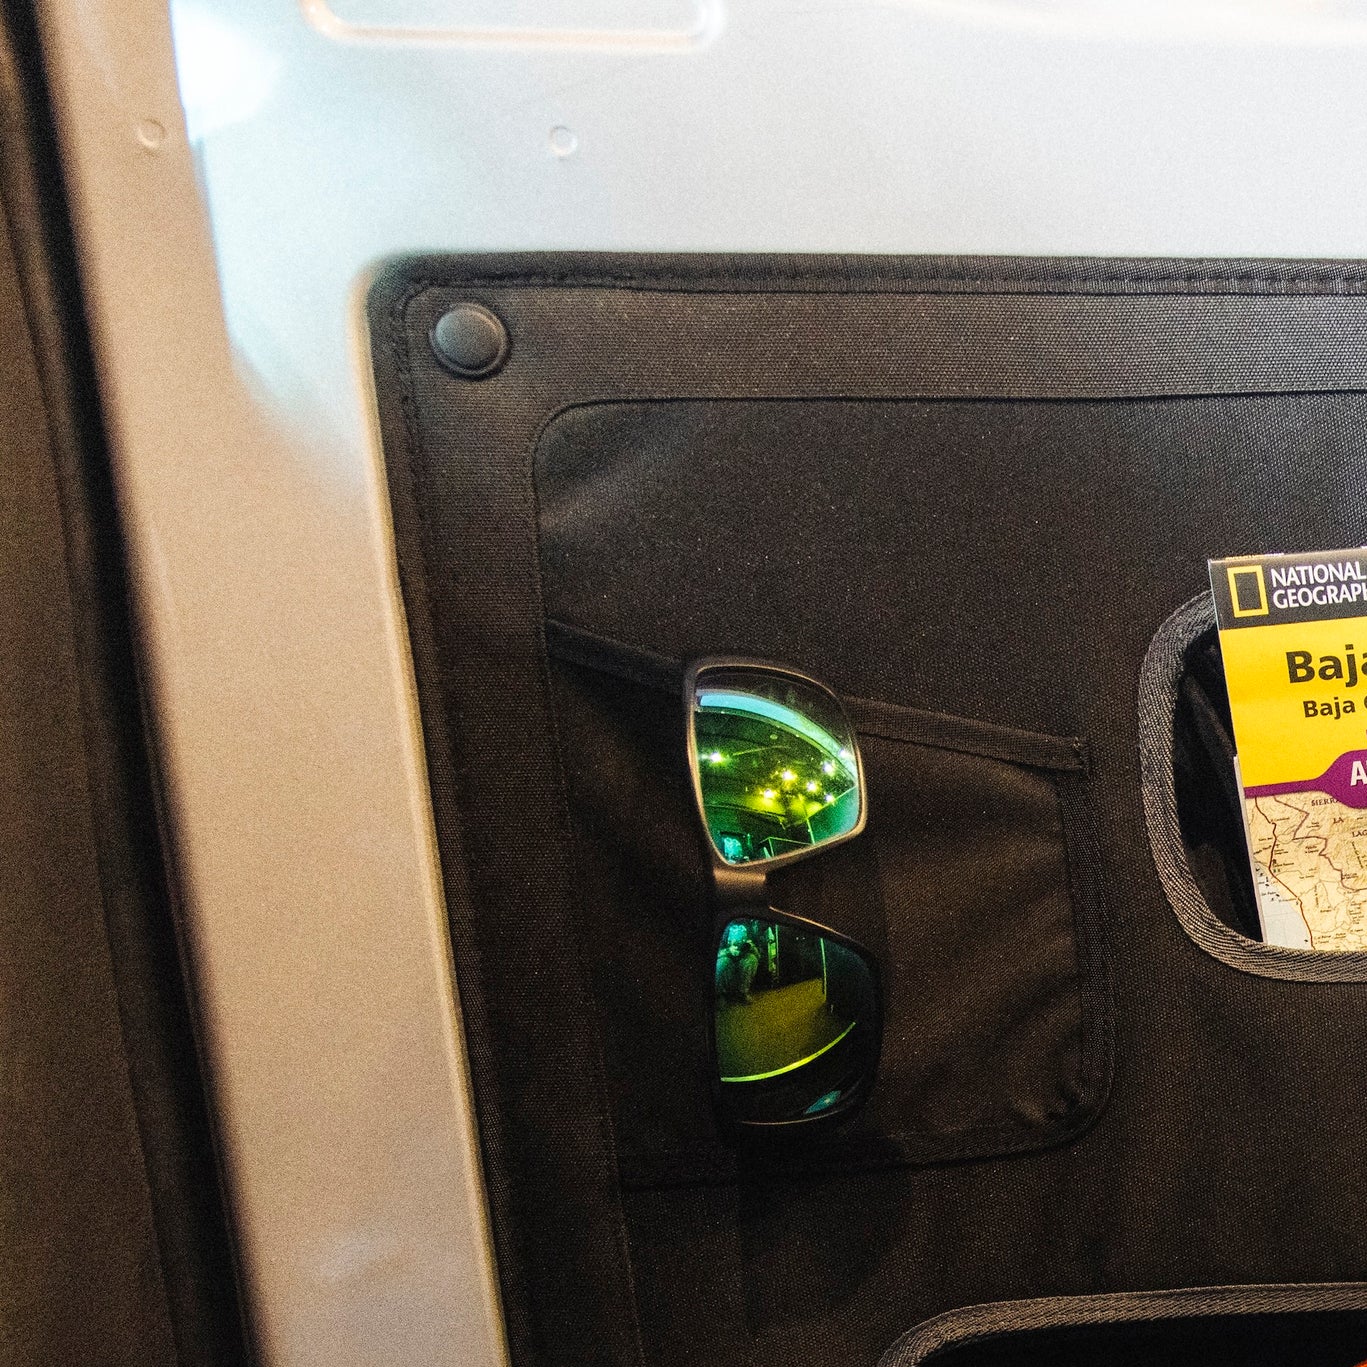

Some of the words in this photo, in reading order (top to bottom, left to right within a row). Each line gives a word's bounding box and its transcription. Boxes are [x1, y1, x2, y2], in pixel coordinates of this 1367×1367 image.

[1270, 561, 1367, 588] NATIONAL
[1302, 695, 1356, 720] Baja
[1333, 816, 1345, 825] LA
